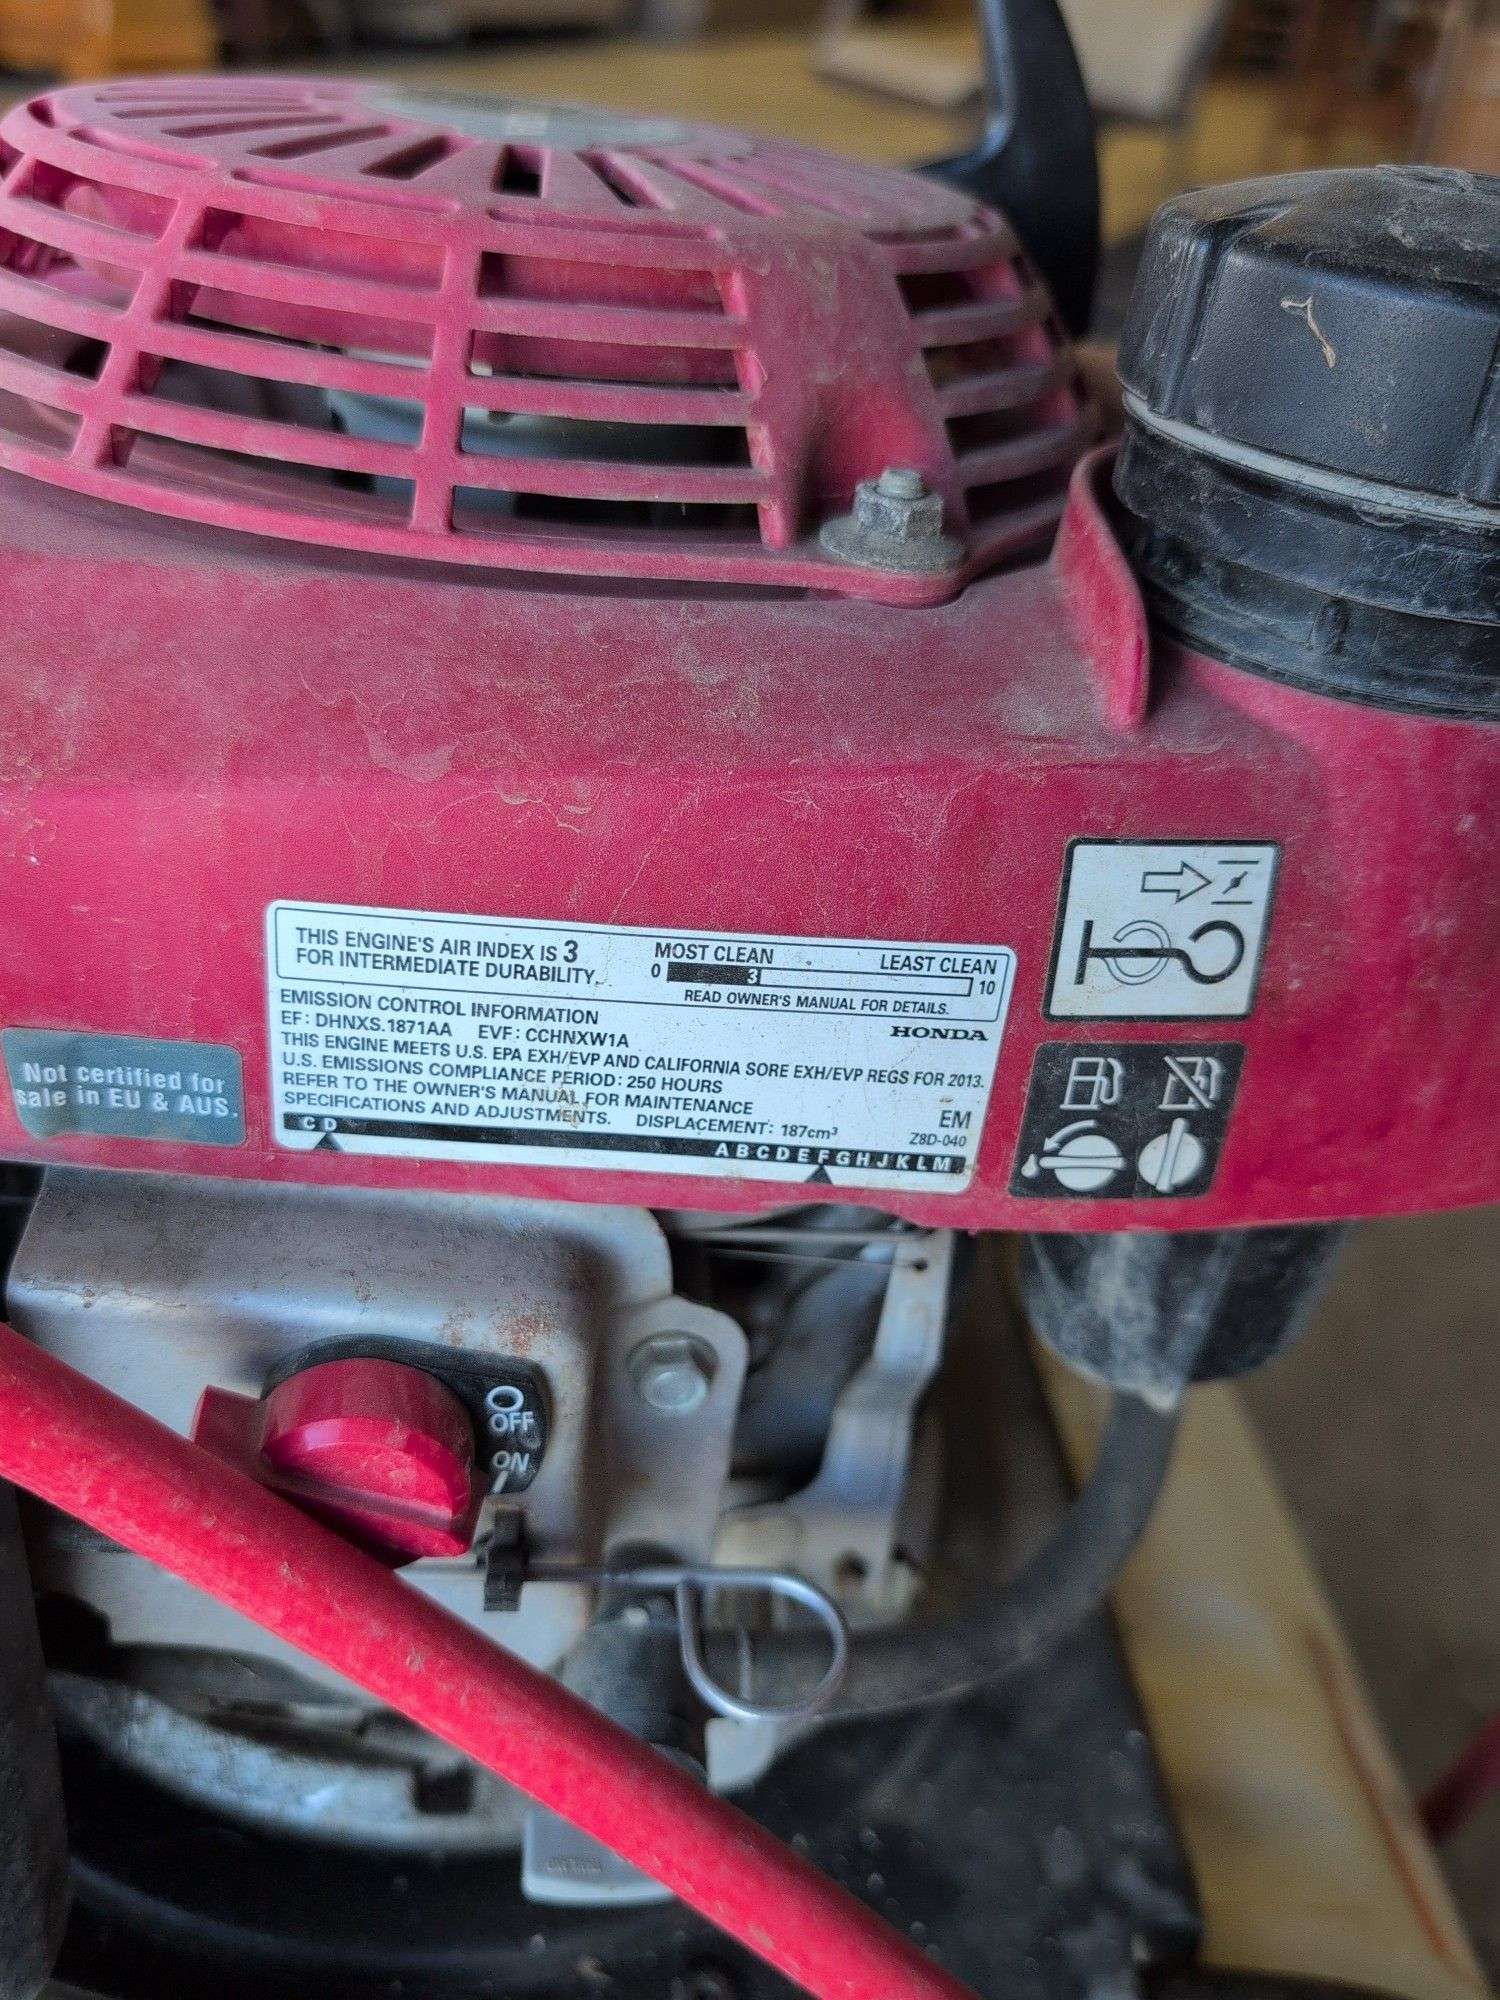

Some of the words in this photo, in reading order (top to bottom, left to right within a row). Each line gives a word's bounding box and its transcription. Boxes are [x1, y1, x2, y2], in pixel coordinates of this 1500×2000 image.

[296, 927, 339, 945] THIS
[346, 931, 434, 953] ENGINE'S
[440, 939, 470, 956] AIR
[477, 941, 535, 960] INDEX
[540, 946, 557, 962] IS
[563, 940, 579, 963] 3
[654, 942, 709, 960] MOST
[714, 946, 774, 964] CLEAN
[296, 948, 334, 966] FOR
[340, 951, 479, 977] INTERMEDIATE
[485, 963, 600, 985] DURABILITY.
[651, 963, 660, 978] 0
[747, 969, 758, 984] 3
[979, 981, 995, 995] 10
[880, 954, 935, 972] LEAST
[940, 957, 997, 974] CLEAN
[280, 989, 372, 1009] EMISSION
[378, 996, 466, 1016] CONTROL
[471, 1003, 599, 1025] INFORMATION
[684, 990, 721, 1003] READ
[727, 992, 791, 1007] OWNER'S
[796, 996, 856, 1010] MANUAL
[861, 999, 887, 1011] FOR
[893, 1001, 949, 1014] DETAILS.
[316, 1012, 452, 1036] DHNXS.1871AA
[526, 1028, 629, 1048] CCHNXW1A
[890, 1025, 989, 1041] HONDA
[281, 1032, 319, 1047] THIS
[325, 1035, 388, 1052] ENGINE
[394, 1040, 450, 1057] MEETS
[456, 1044, 487, 1059] U.S.
[493, 1047, 522, 1061] EPA
[528, 1049, 600, 1065] EXH/EVP
[604, 1054, 639, 1069] AND
[645, 1056, 740, 1075] CALIFORNIA
[746, 1062, 789, 1078] SORE
[793, 1065, 863, 1082] EXH/EVP
[867, 1069, 909, 1085] REGS
[913, 1072, 944, 1086] FOR
[948, 1074, 984, 1088] 2013.
[283, 1052, 316, 1067] U.S.
[322, 1054, 423, 1075] EMISSIONS
[429, 1063, 546, 1083] COMPLIANCE
[552, 1071, 622, 1087] PERIOD:
[627, 1076, 656, 1089] 250
[661, 1077, 723, 1093] HOURS
[22, 1063, 68, 1083] Not
[77, 1066, 182, 1091] certified
[191, 1072, 225, 1094] for
[283, 1072, 338, 1088] REFER
[344, 1076, 367, 1091] TO
[374, 1078, 407, 1093] THE
[413, 1082, 496, 1099] OWNER'S
[501, 1087, 579, 1104] MANUAL
[585, 1092, 619, 1107] FOR
[624, 1094, 753, 1115] MAINTENANCE
[14, 1088, 67, 1108] sale
[77, 1085, 100, 1105] in
[110, 1088, 141, 1109] EU
[152, 1092, 169, 1112] &
[179, 1095, 238, 1117] AUS.
[284, 1092, 425, 1113] SPECIFICATIONS
[431, 1102, 469, 1116] AND
[474, 1105, 610, 1125] ADJUSTMENTS.
[636, 1114, 774, 1135] DISPLACEMENT:
[939, 1110, 972, 1129] EM
[909, 1132, 967, 1147] Z8D-040
[490, 1411, 534, 1432] OFF
[492, 1450, 529, 1472] ON
